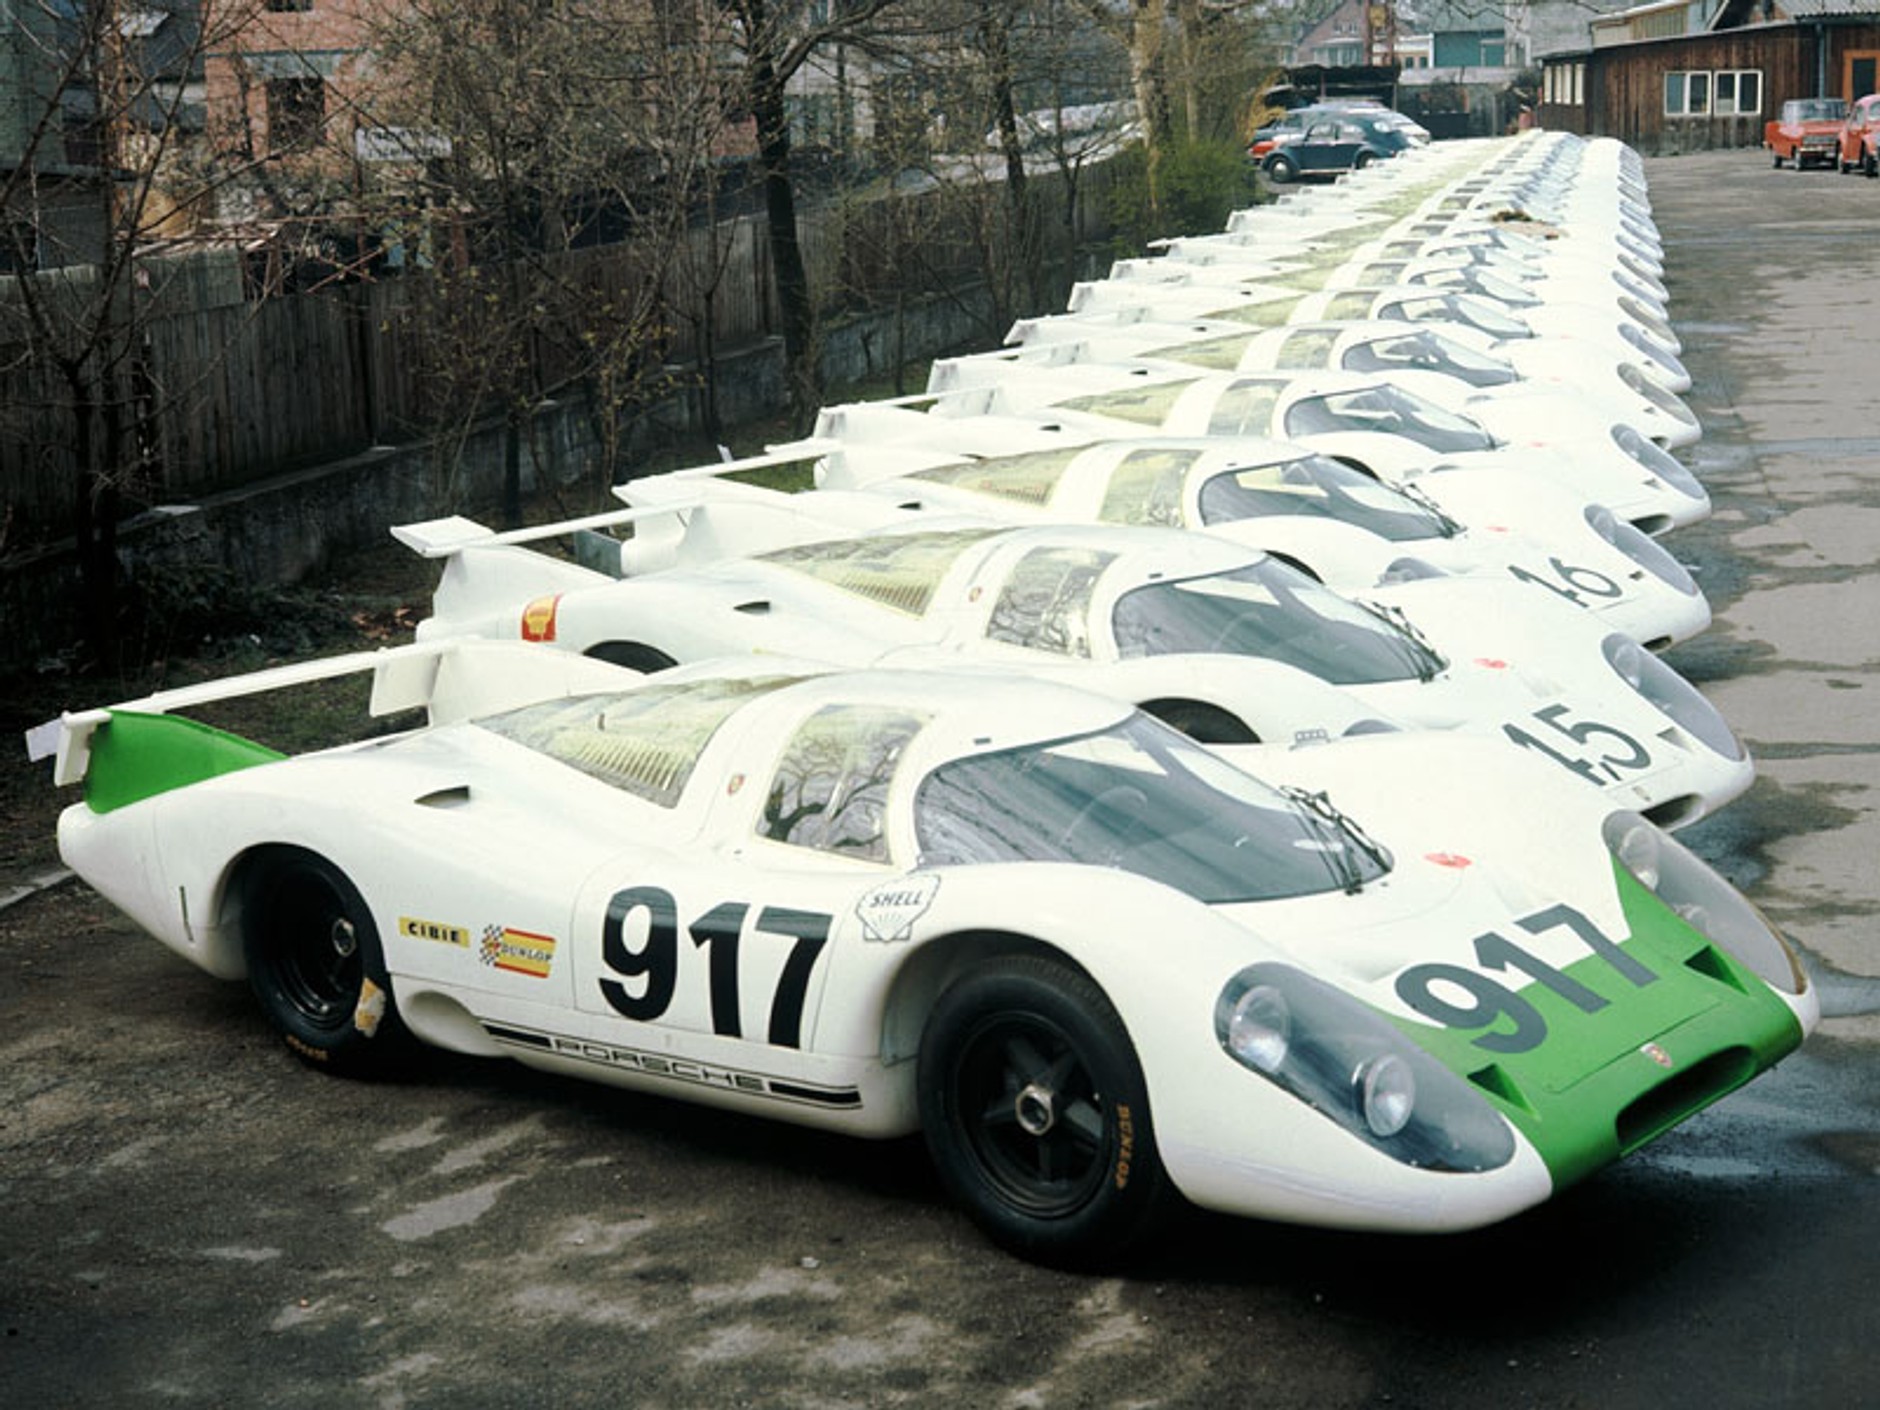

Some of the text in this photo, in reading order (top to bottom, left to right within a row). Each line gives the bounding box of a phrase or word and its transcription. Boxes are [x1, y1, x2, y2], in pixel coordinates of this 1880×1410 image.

[1508, 556, 1623, 608] 16
[1502, 703, 1652, 786] 15
[869, 889, 923, 908] SHELL
[500, 942, 553, 962] DUNLOP
[598, 885, 834, 1051] 917
[1395, 903, 1660, 1055] 917
[554, 1038, 765, 1092] PORSCHE
